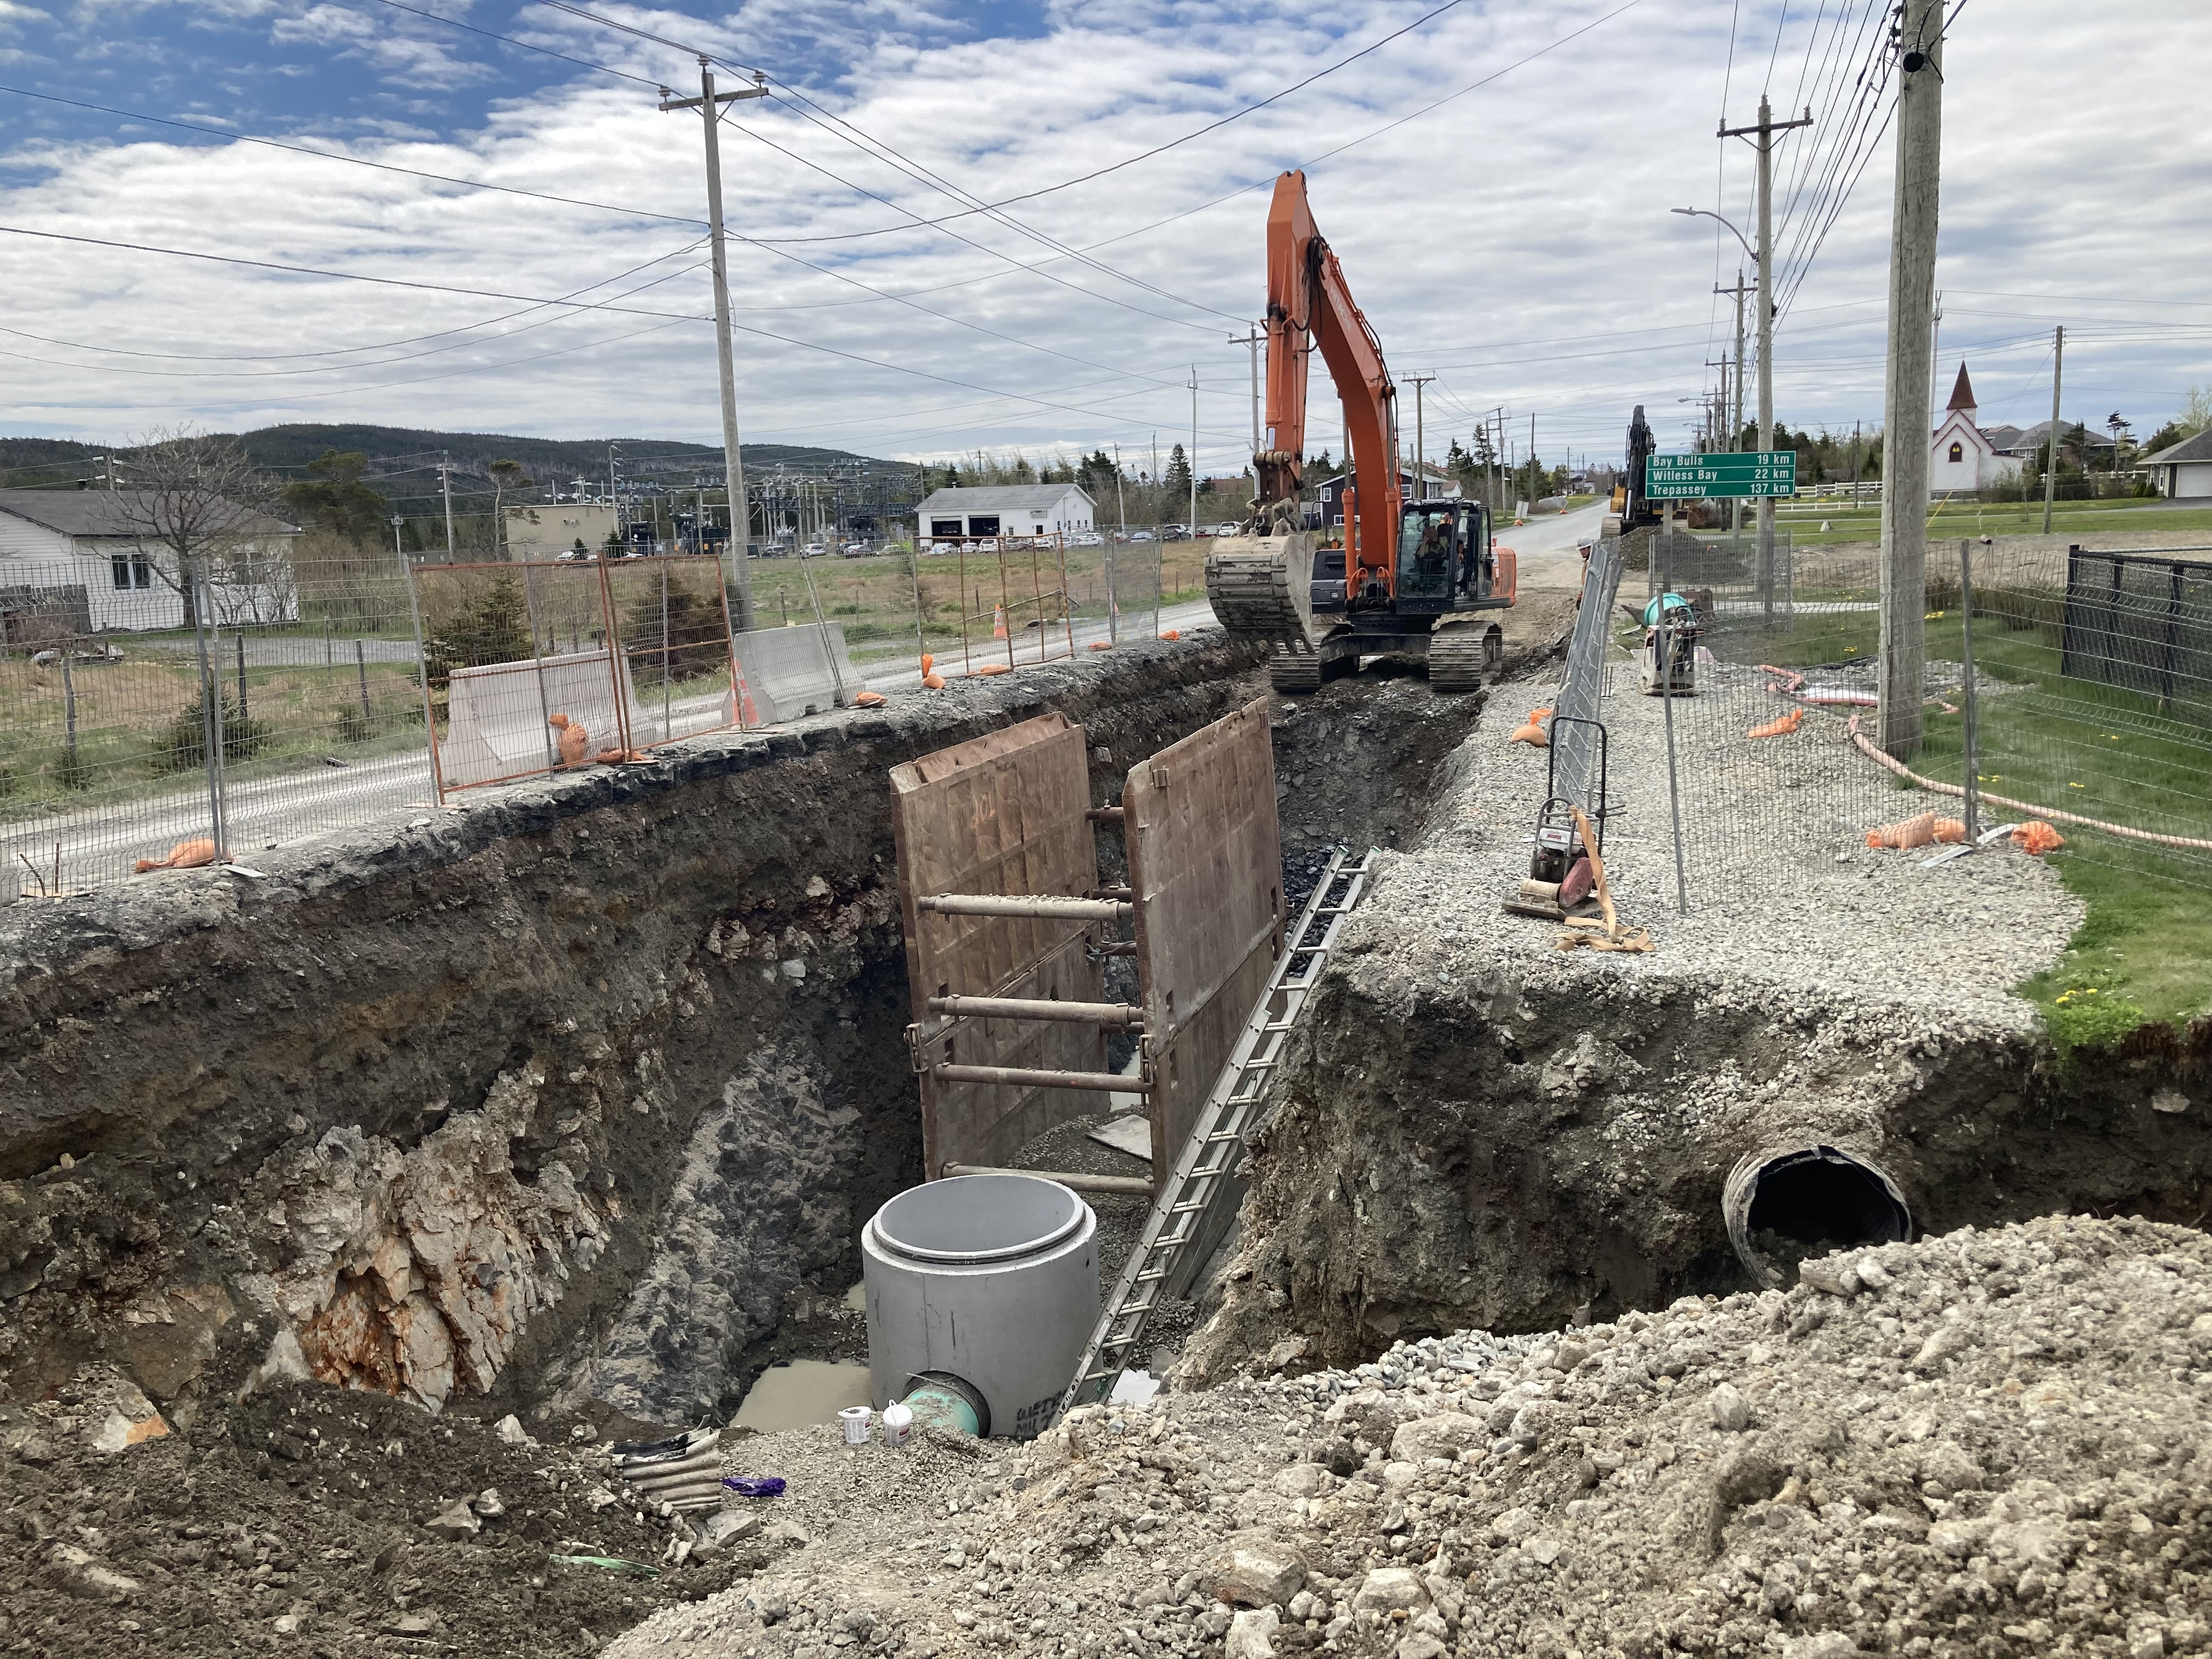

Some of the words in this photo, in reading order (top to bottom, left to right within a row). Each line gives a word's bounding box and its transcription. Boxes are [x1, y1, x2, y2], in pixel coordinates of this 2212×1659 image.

[1330, 284, 1351, 332] HITACHI
[1653, 456, 1672, 469] Bay
[1677, 455, 1703, 466] Bulls
[1757, 454, 1769, 465] 19
[1774, 454, 1790, 465] km
[1653, 470, 1693, 481] Witless
[1698, 470, 1717, 482] Bay
[1754, 469, 1768, 479] 22
[1773, 469, 1789, 479] km
[1652, 484, 1706, 496] Trepassey
[1750, 483, 1769, 494] 137
[1773, 483, 1789, 493] km
